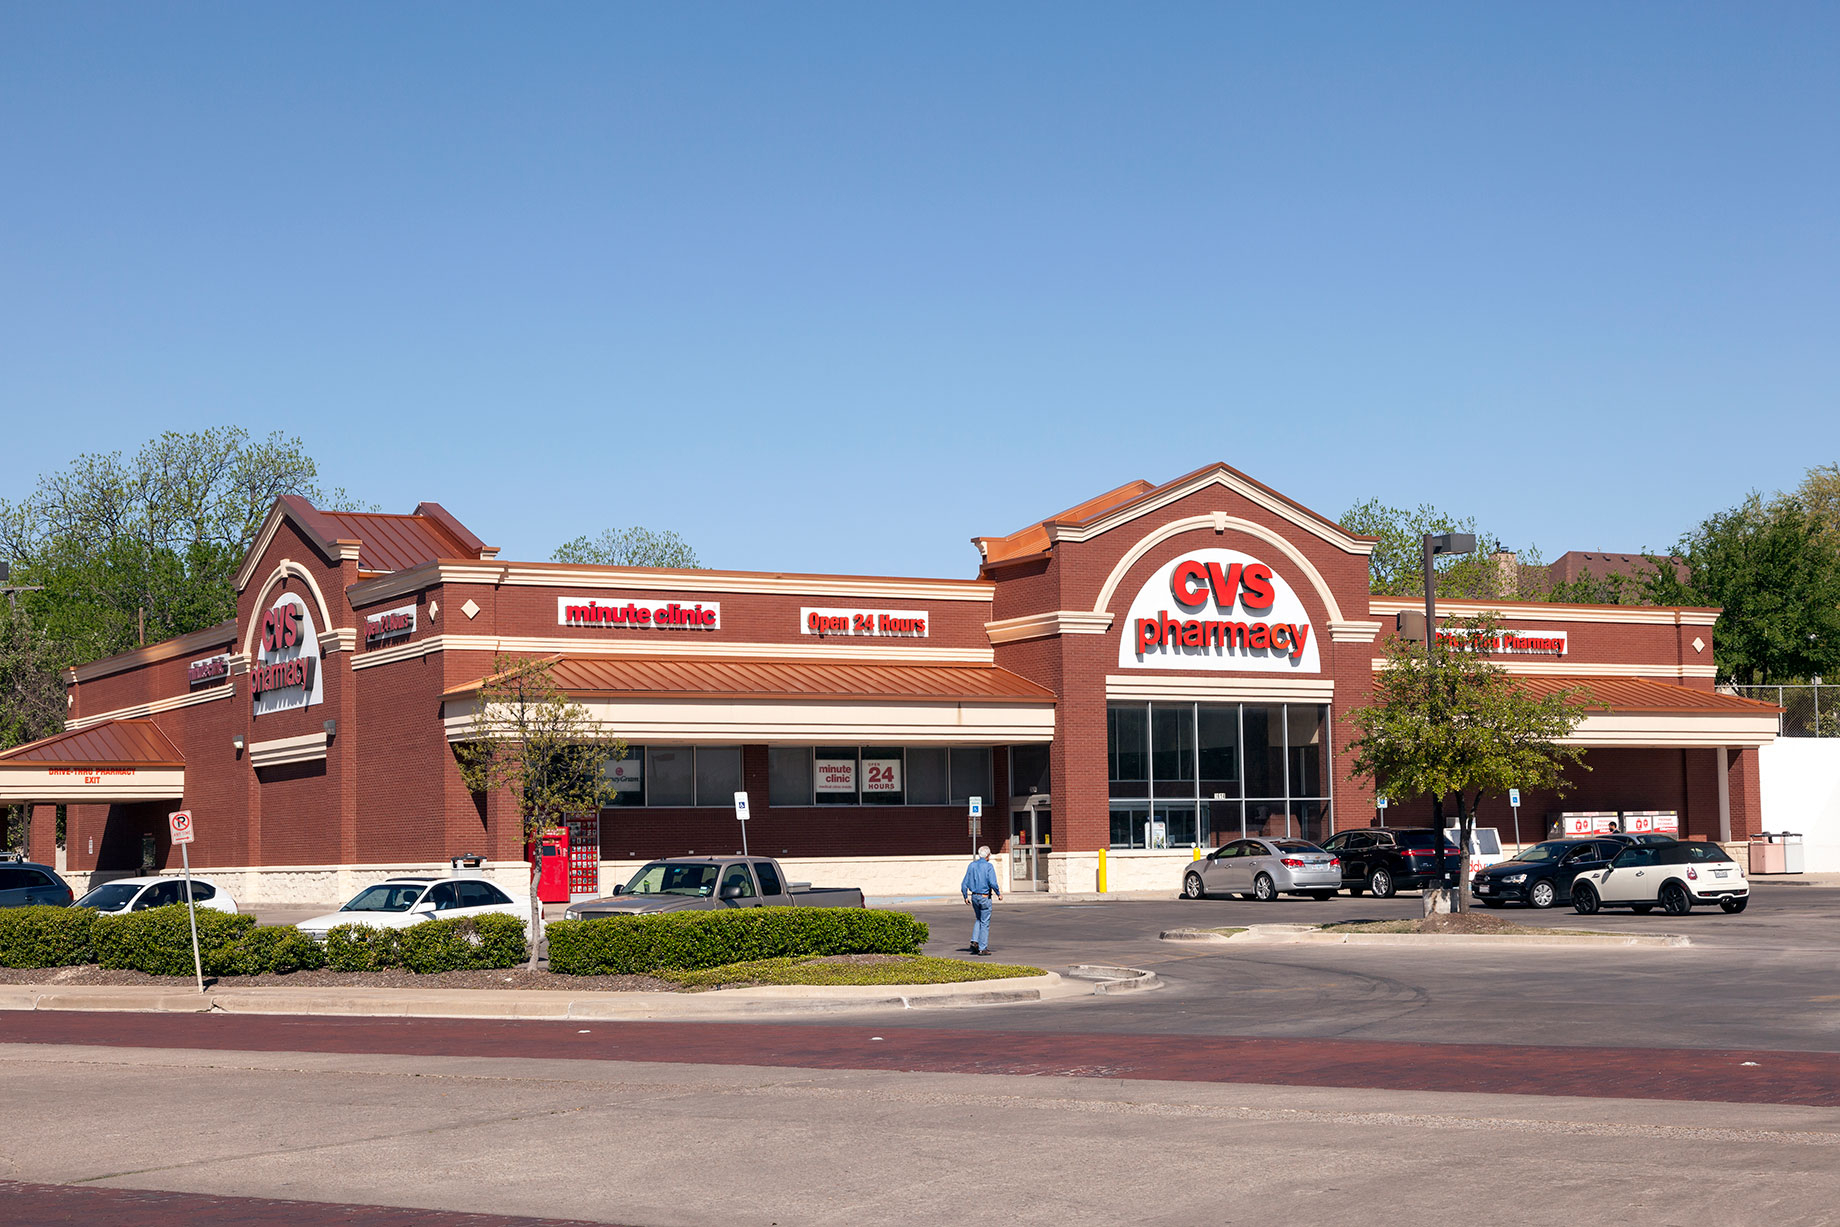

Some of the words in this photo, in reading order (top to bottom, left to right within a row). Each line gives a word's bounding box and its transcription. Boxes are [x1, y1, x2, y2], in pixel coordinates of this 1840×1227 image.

[1172, 560, 1275, 609] CVS
[566, 601, 651, 624] minute
[653, 603, 716, 625] clinic
[808, 612, 849, 633] Open
[854, 614, 875, 631] 24
[879, 614, 926, 632] Hours
[262, 603, 300, 652] CVS
[364, 618, 380, 640] Open
[381, 615, 389, 632] 24
[390, 613, 410, 631] Hours
[1136, 610, 1309, 658] pharmacy
[1504, 635, 1565, 653] Pharmacy
[251, 656, 311, 700] pharmacy
[49, 768, 93, 776] DRIVE-THRU
[96, 768, 136, 776] PHARMACY
[819, 764, 852, 774] minute
[825, 774, 851, 783] clinic
[868, 767, 895, 783] 24
